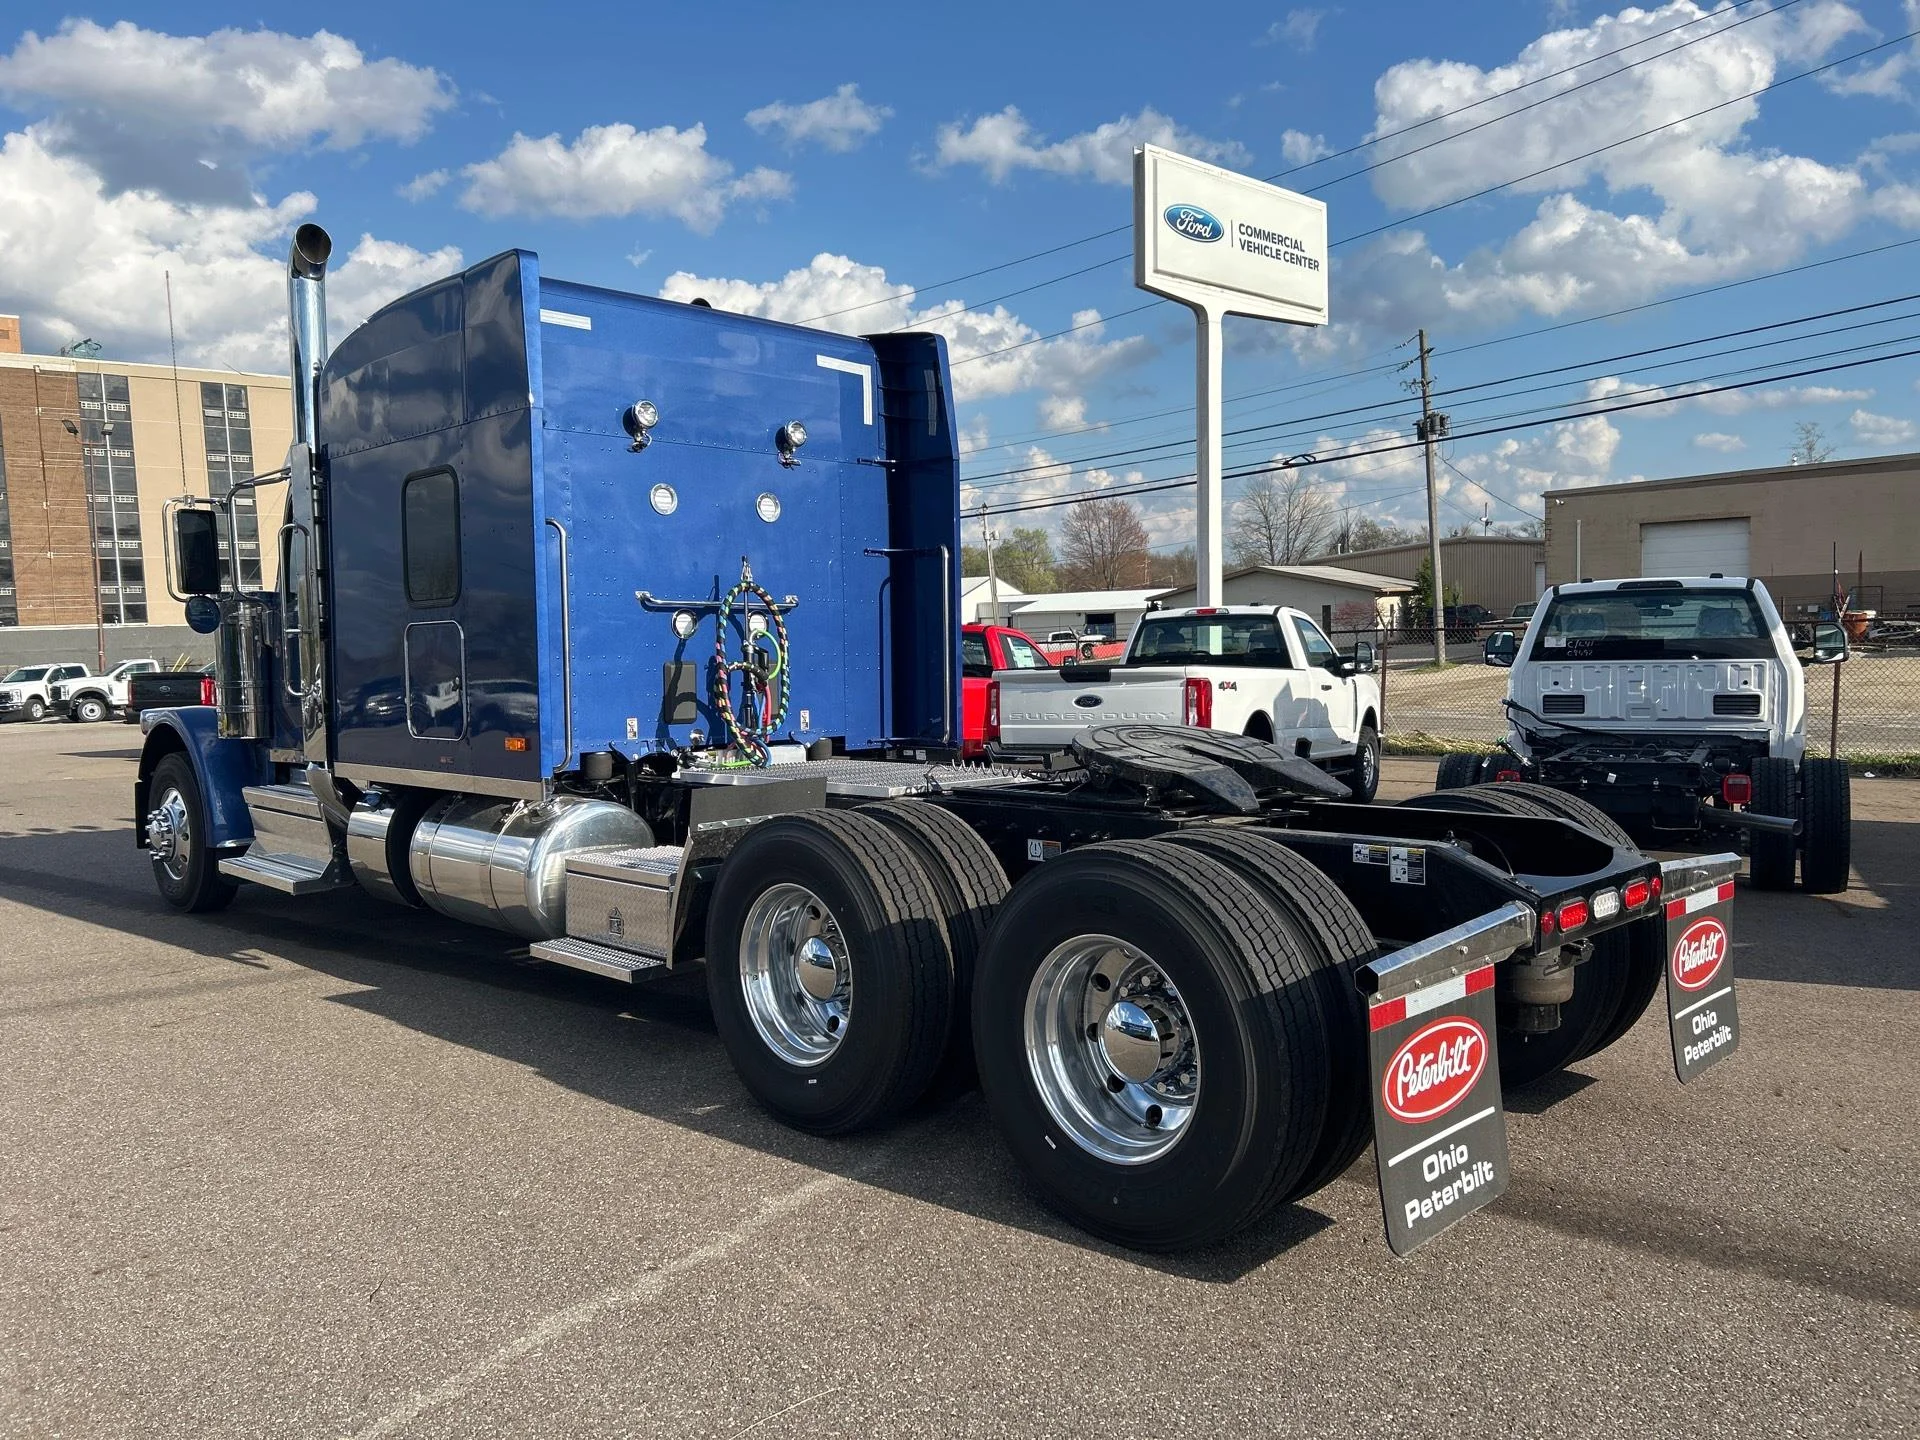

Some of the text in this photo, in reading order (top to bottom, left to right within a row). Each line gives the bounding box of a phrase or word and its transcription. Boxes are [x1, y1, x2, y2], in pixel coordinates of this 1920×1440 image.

[1176, 208, 1213, 238] Ford
[1238, 223, 1305, 253] COMMERCIAL
[1239, 238, 1320, 272] VEHICLE CENTER
[1009, 711, 1175, 721] SUPER DUTY
[1679, 931, 1722, 978] Peterbilt
[1692, 1009, 1718, 1035] Ohio
[1684, 1025, 1732, 1066] Peterbilt
[1396, 1035, 1478, 1107] Peterbilt
[1422, 1143, 1469, 1183] Ohio
[1404, 1160, 1495, 1229] Peterbilt
